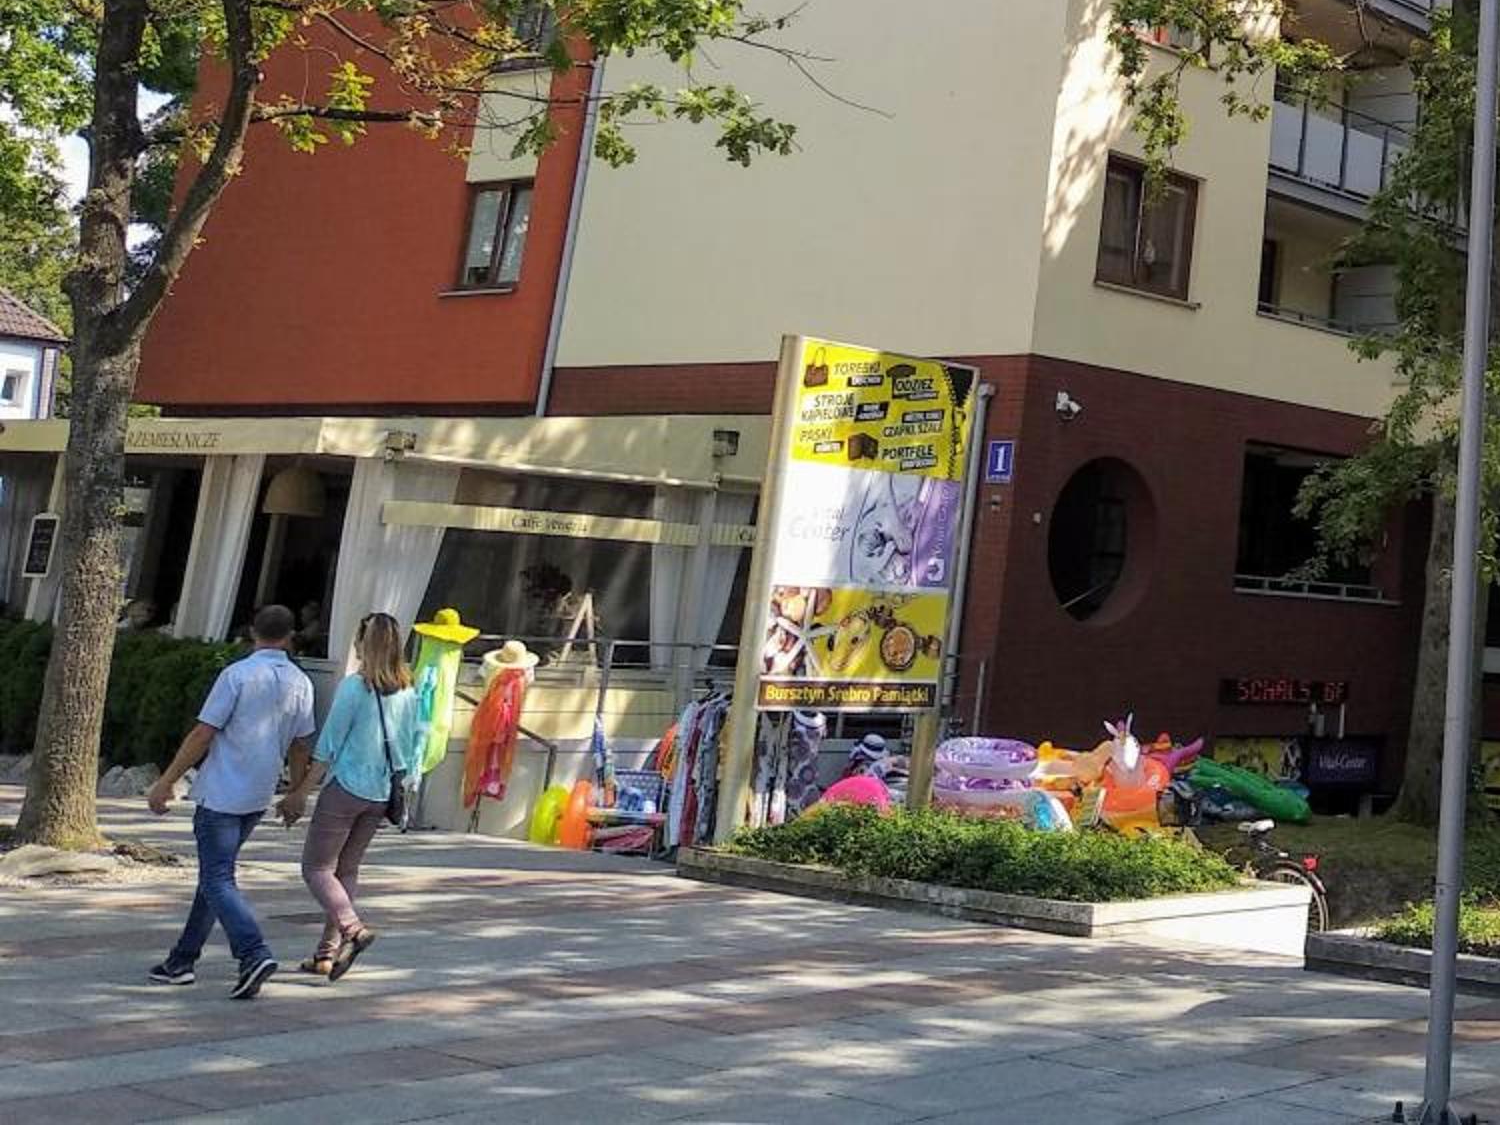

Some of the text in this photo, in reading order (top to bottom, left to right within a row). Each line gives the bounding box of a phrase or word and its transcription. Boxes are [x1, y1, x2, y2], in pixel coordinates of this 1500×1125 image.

[814, 393, 855, 408] STROJE
[882, 444, 934, 460] PORTFELE
[994, 446, 1006, 472] 1
[765, 684, 825, 703] Bursztyn
[828, 686, 871, 701] Srebro
